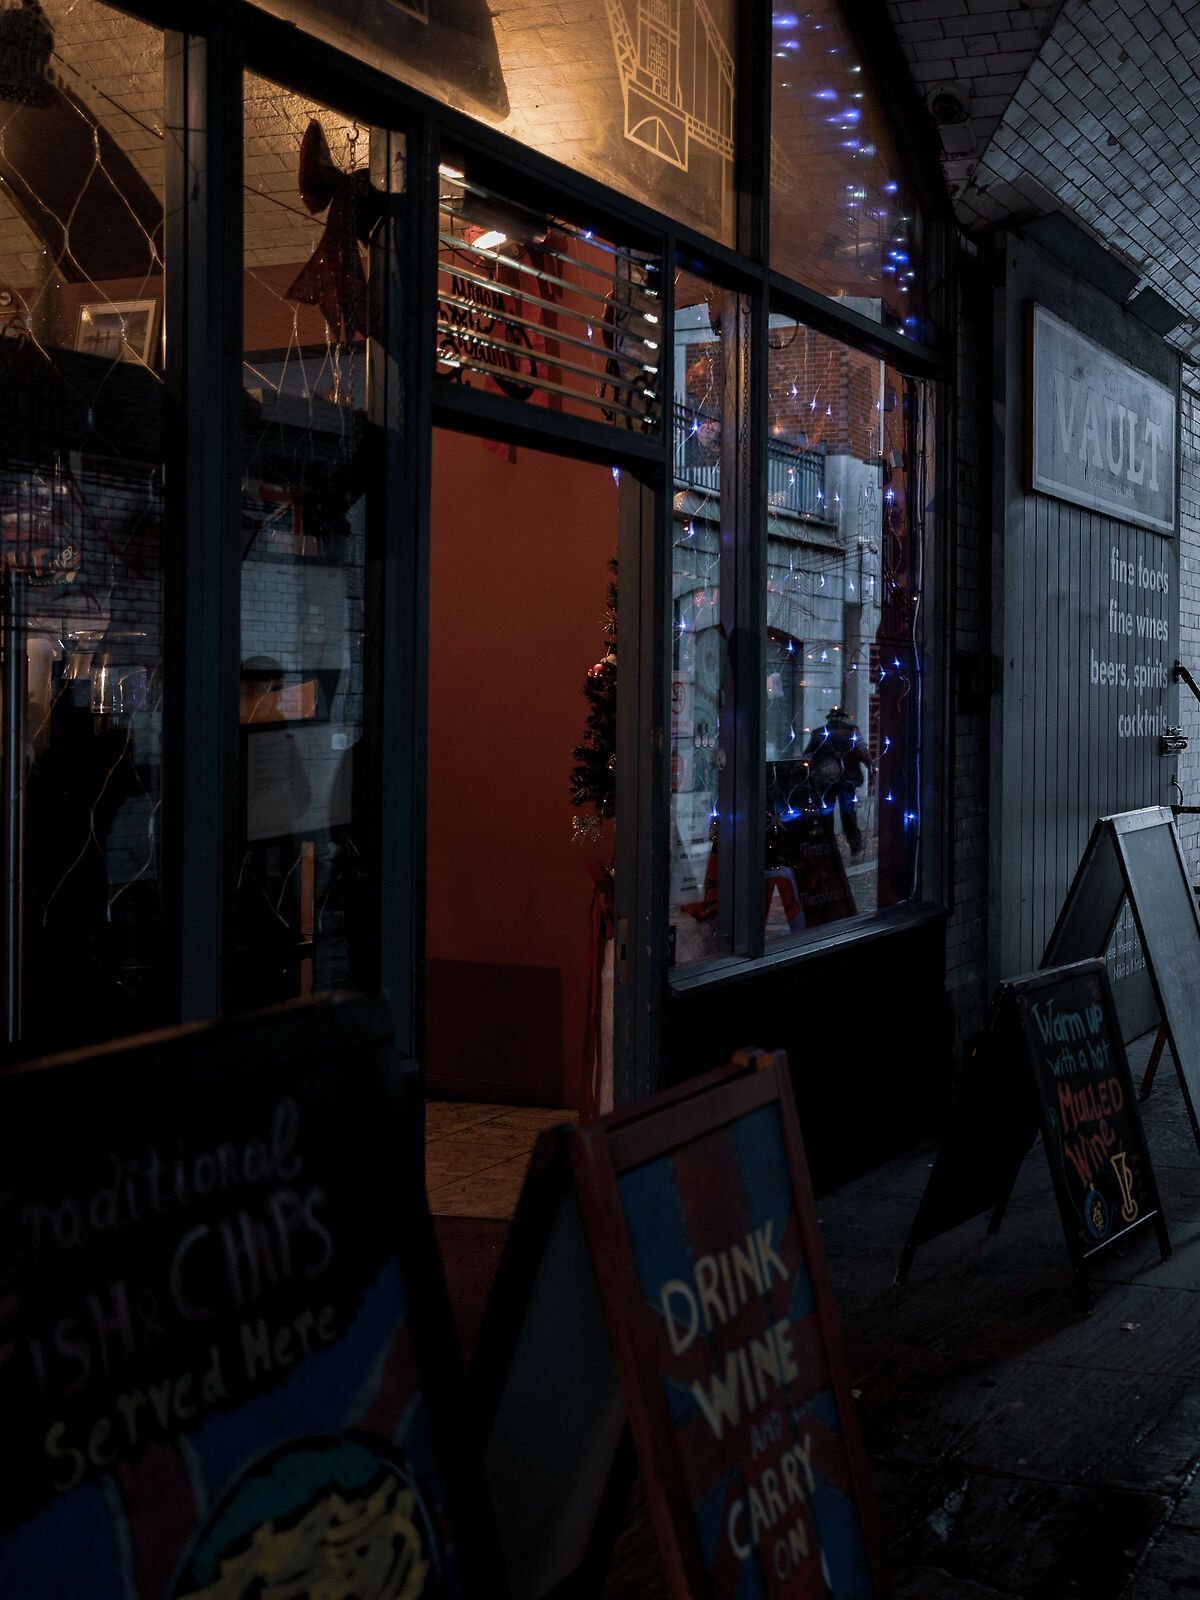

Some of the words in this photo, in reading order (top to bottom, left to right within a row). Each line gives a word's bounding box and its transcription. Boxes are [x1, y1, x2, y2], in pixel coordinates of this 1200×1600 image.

[1053, 367, 1163, 493] VAULT
[1110, 546, 1135, 587] fine
[1138, 555, 1169, 595] foods
[1109, 598, 1133, 637] fine
[1136, 608, 1169, 642] wines
[1090, 648, 1131, 693] beers,
[1133, 656, 1168, 697] spirits
[1118, 704, 1168, 738] cocktails
[1031, 998, 1087, 1046] Warm
[1085, 1001, 1103, 1036] up
[1045, 1046, 1078, 1078] with
[1078, 1049, 1088, 1071] a
[1087, 1038, 1111, 1073] hot
[0, 1096, 305, 1266] raditional
[168, 1183, 336, 1323] CHIPS
[660, 1219, 790, 1357] DRINK
[42, 1343, 231, 1493] Served
[239, 1303, 337, 1383] Here
[691, 1315, 800, 1442] WINE
[751, 1409, 784, 1461] AND
[727, 1432, 817, 1561] CARRY
[772, 1516, 810, 1581] ON
